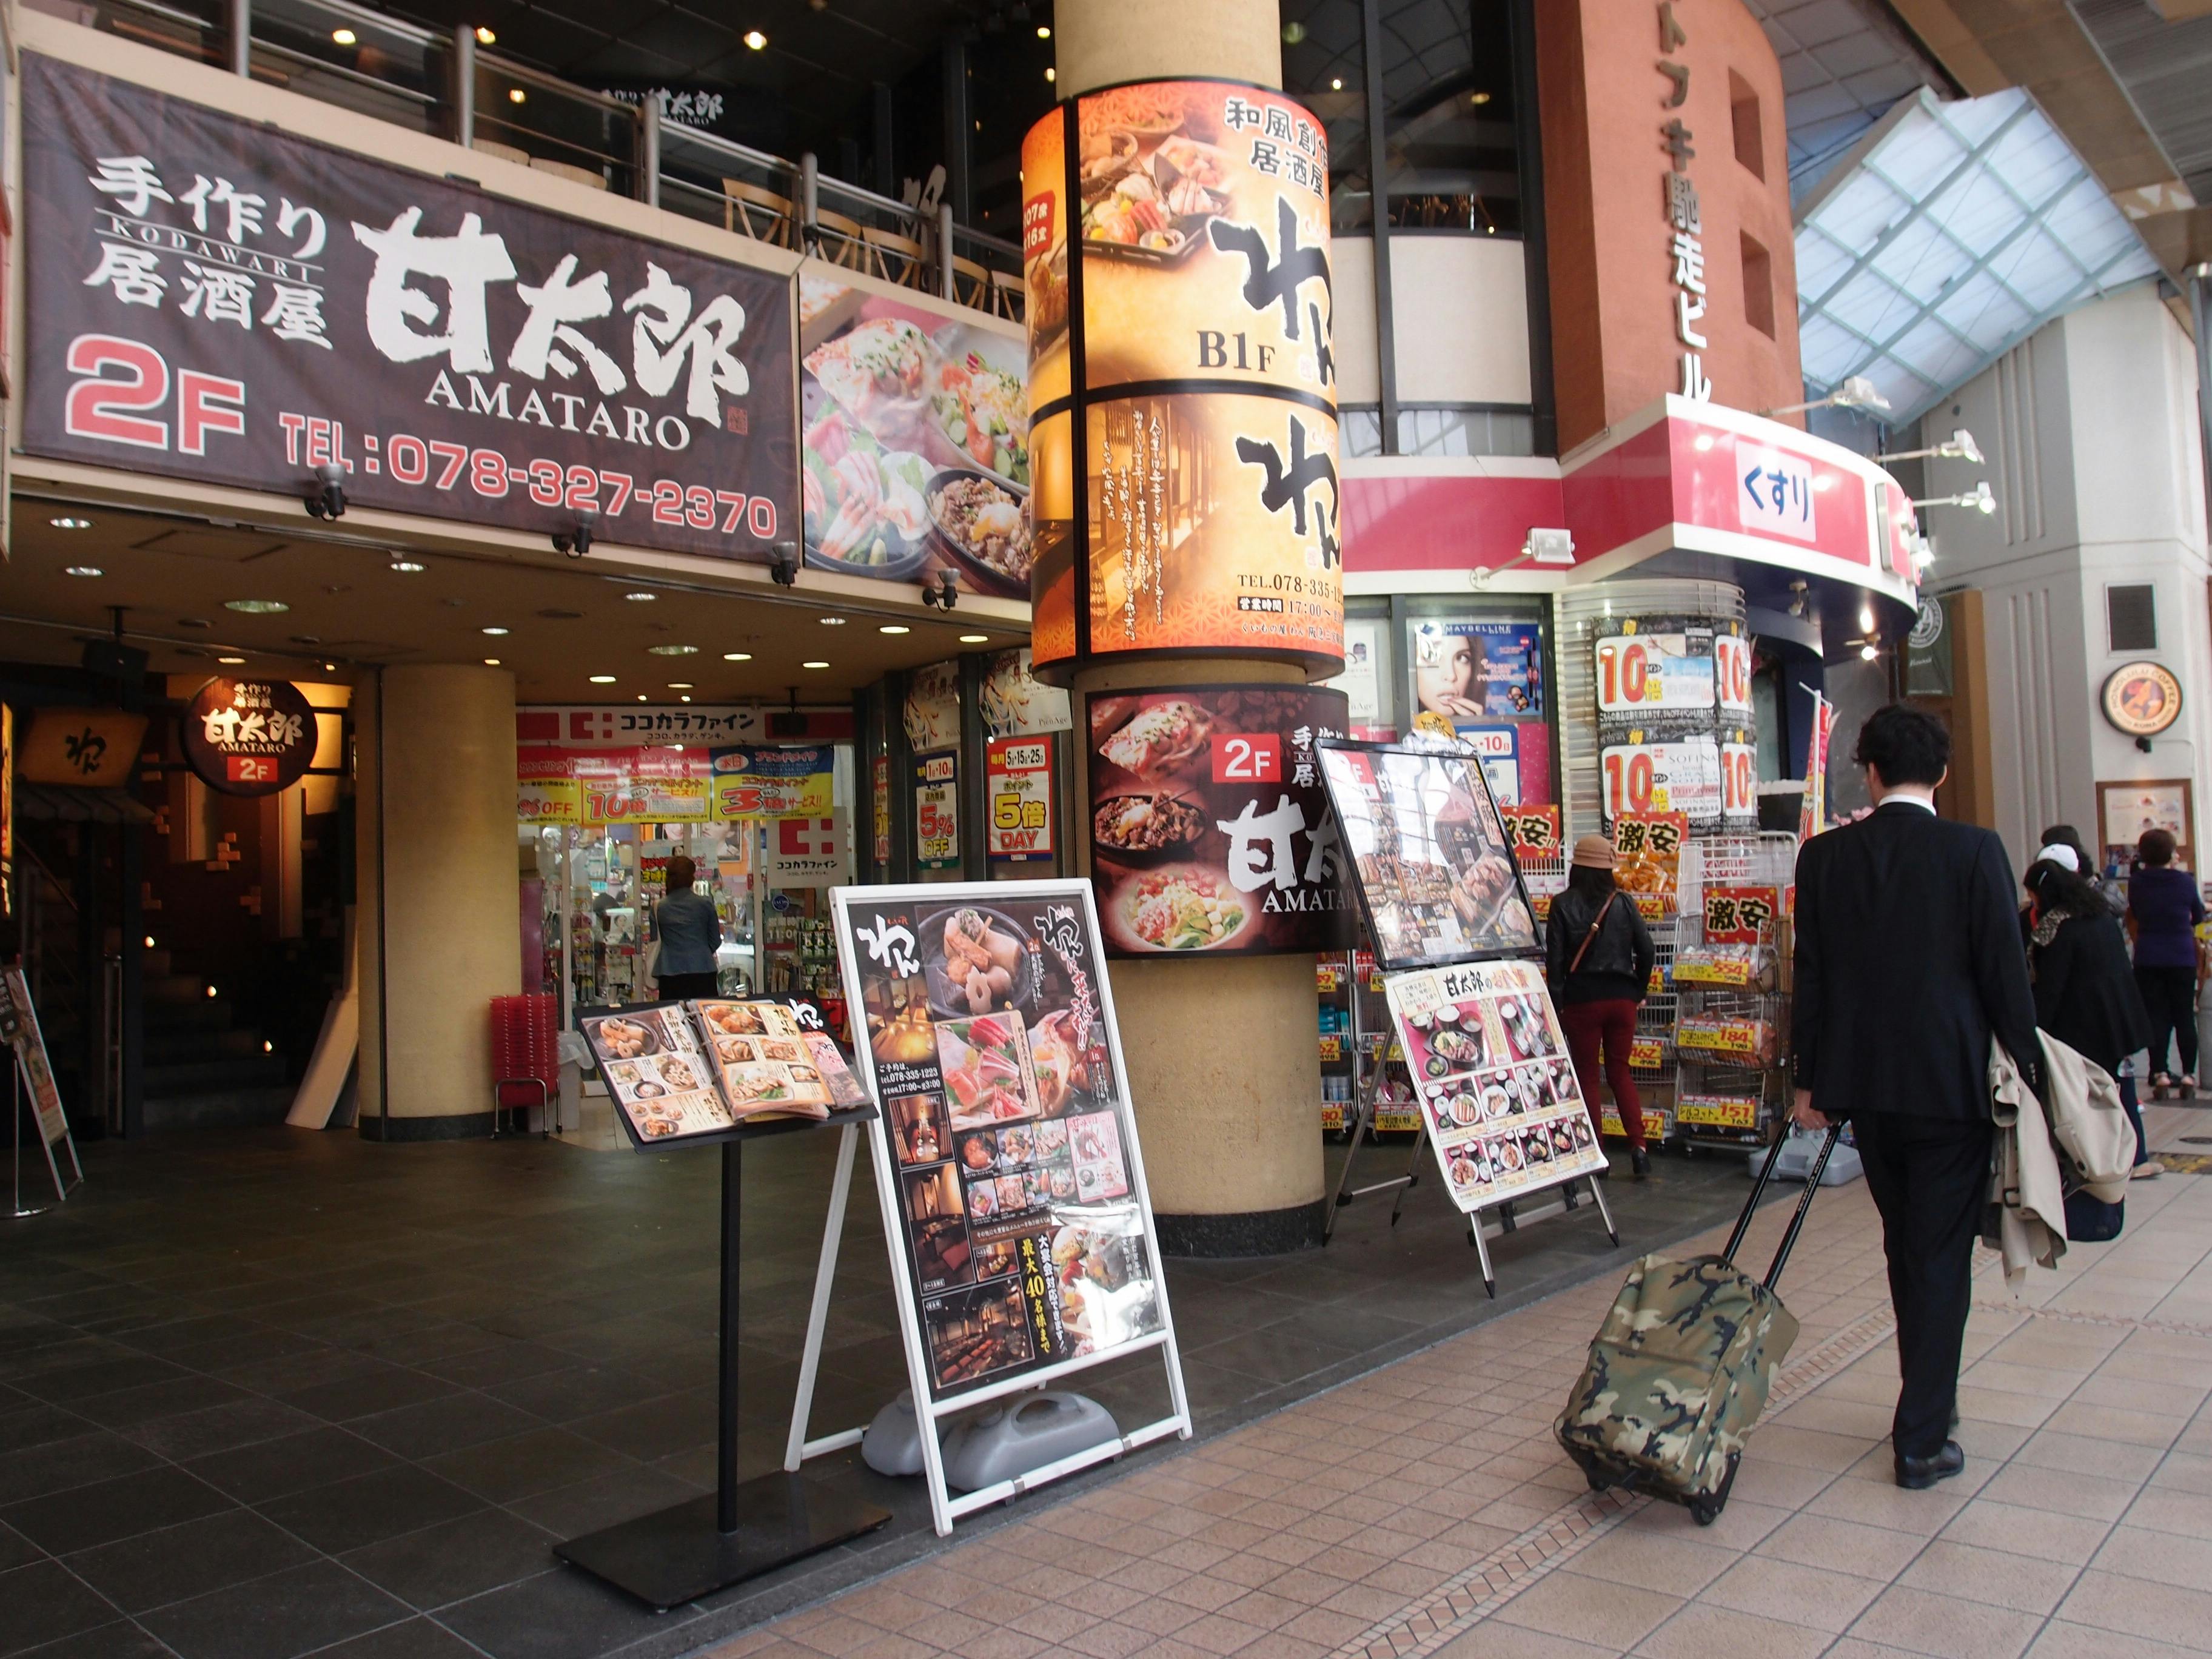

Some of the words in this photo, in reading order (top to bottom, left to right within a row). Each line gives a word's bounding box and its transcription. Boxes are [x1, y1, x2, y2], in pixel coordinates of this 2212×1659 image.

[1252, 139, 1325, 202] 居酒屋
[89, 155, 327, 259] 手作り
[111, 215, 309, 282] KODAWARI
[82, 241, 333, 350] 居酒屋
[350, 206, 749, 428] 甘太郎
[1196, 330, 1275, 372] B1F
[65, 333, 245, 456] 2F
[424, 369, 690, 451] AMATARO
[1744, 465, 1809, 522] くすり
[201, 707, 303, 746] 甘太郎
[621, 712, 754, 731] ココカラファイン
[218, 742, 286, 752] AMATARO
[1224, 739, 1271, 777] 2F
[240, 759, 268, 780] 2F
[994, 793, 1047, 830] 5倍
[924, 839, 950, 857] OFF
[1000, 831, 1039, 850] DAY
[776, 860, 838, 870] ココカラファイン
[856, 914, 920, 978] わん
[1034, 906, 1084, 959] わん
[1721, 1027, 1749, 1042] 184
